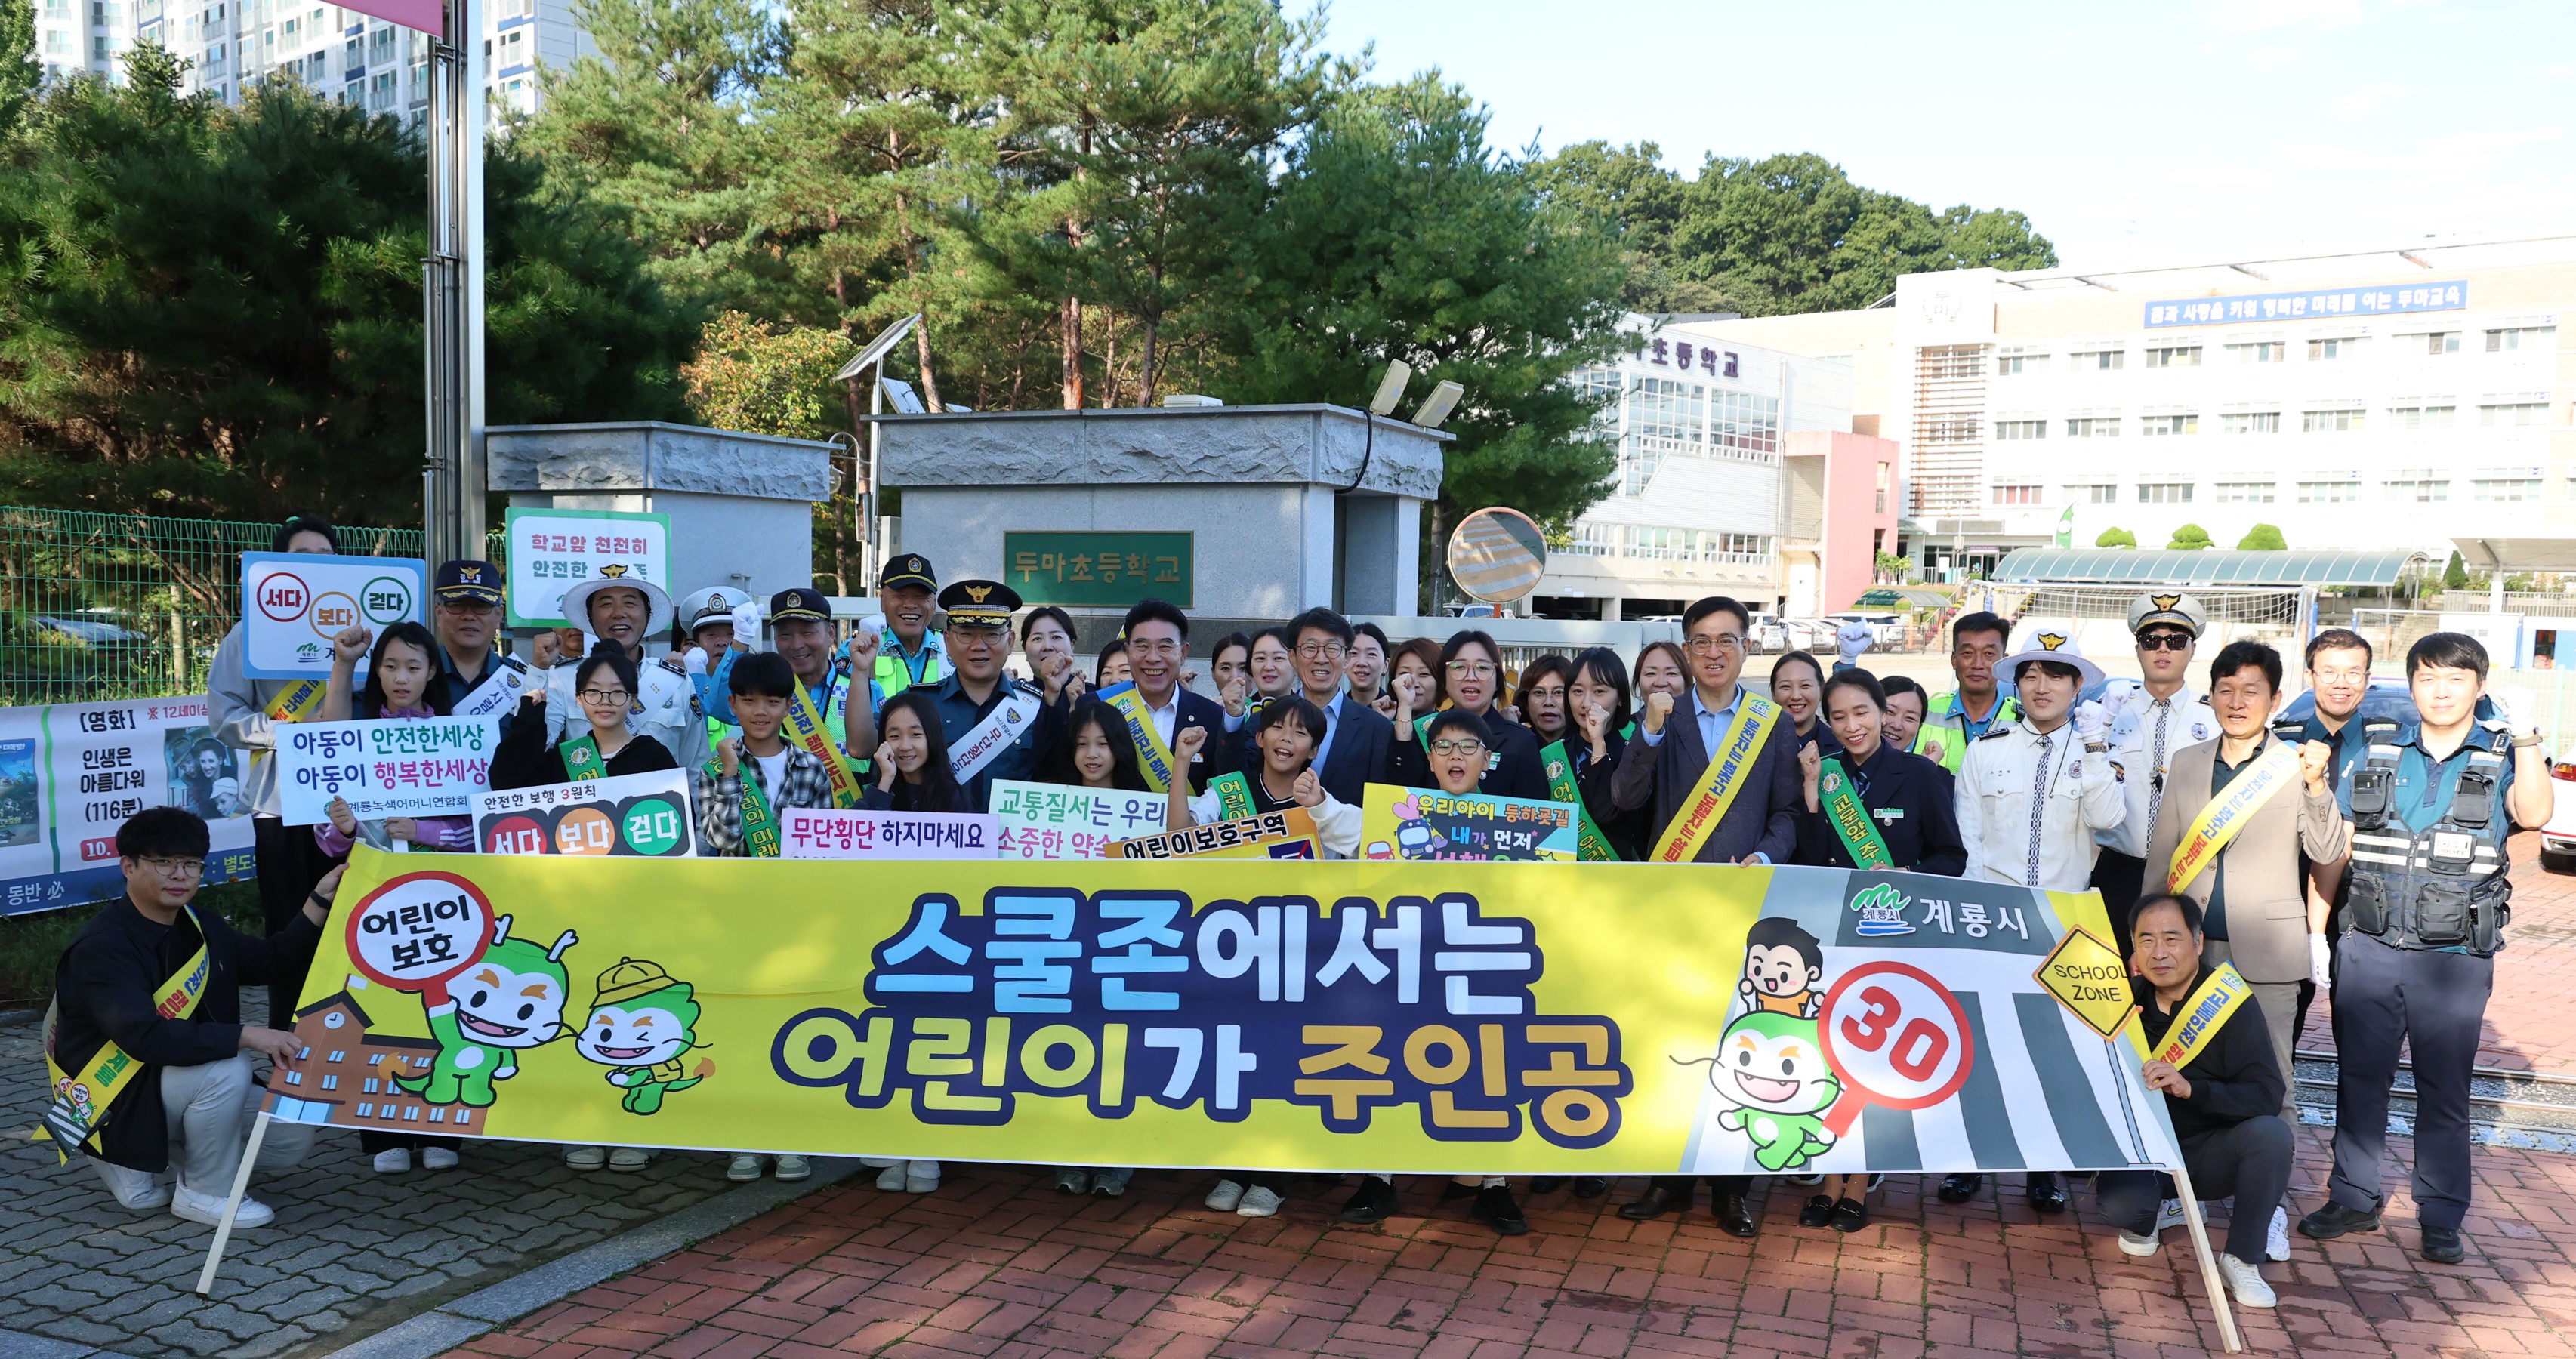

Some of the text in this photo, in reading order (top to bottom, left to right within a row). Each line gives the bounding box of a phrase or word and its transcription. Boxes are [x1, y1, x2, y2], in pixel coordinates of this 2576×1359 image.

[2229, 300, 2257, 319] 키워
[2312, 294, 2356, 313] 미래를
[2362, 291, 2392, 310] 여는
[2398, 286, 2460, 309] 두마교육
[1635, 337, 1738, 378] 초등학교
[532, 534, 647, 555] 학교앞 천천히
[532, 560, 588, 578] 안전한
[1015, 552, 1180, 584] 두마초등학교
[265, 589, 302, 608] 서다
[369, 593, 403, 611] 걷다
[317, 608, 353, 627] 보다
[80, 709, 136, 733] [영화]
[293, 724, 484, 759] 아동이 안전한세상
[957, 727, 1002, 769] 무단횡단
[82, 747, 132, 770] 인생은
[1149, 757, 1172, 792] 멈추
[81, 769, 145, 794] 아름다워
[296, 757, 488, 794] 아동이 행복한세상
[1663, 718, 1760, 862] 운전자는 멈추고 보행자는 살피
[85, 797, 143, 822] (116분)
[484, 784, 596, 811] 안전한 보행 3원칙
[998, 789, 1112, 826] 교통질서는
[1220, 781, 1249, 819] 어린이
[1418, 795, 1495, 821] 우리아이
[495, 810, 677, 854] 서다 보다 걷다
[791, 818, 985, 850] 무단횡단 하지마세요
[1832, 794, 1869, 843] 교문앞
[998, 827, 1063, 859] 소중한
[1124, 813, 1289, 858] 어린이보호구역
[1451, 826, 1532, 850] 내가 먼저
[7, 883, 41, 906] 동반
[362, 895, 470, 935] 어린이
[1863, 908, 1901, 921] 계룡시
[1920, 897, 2029, 940] 계룡시
[392, 934, 458, 972] 보호
[875, 895, 1532, 1015] 스쿨존에서는
[2053, 964, 2127, 981] SCHOOL
[2072, 985, 2122, 1002] ZONE
[1841, 986, 1949, 1082] 30
[2178, 987, 2232, 1049] 교통안전
[782, 1015, 1621, 1138] 어린이가 주인공
